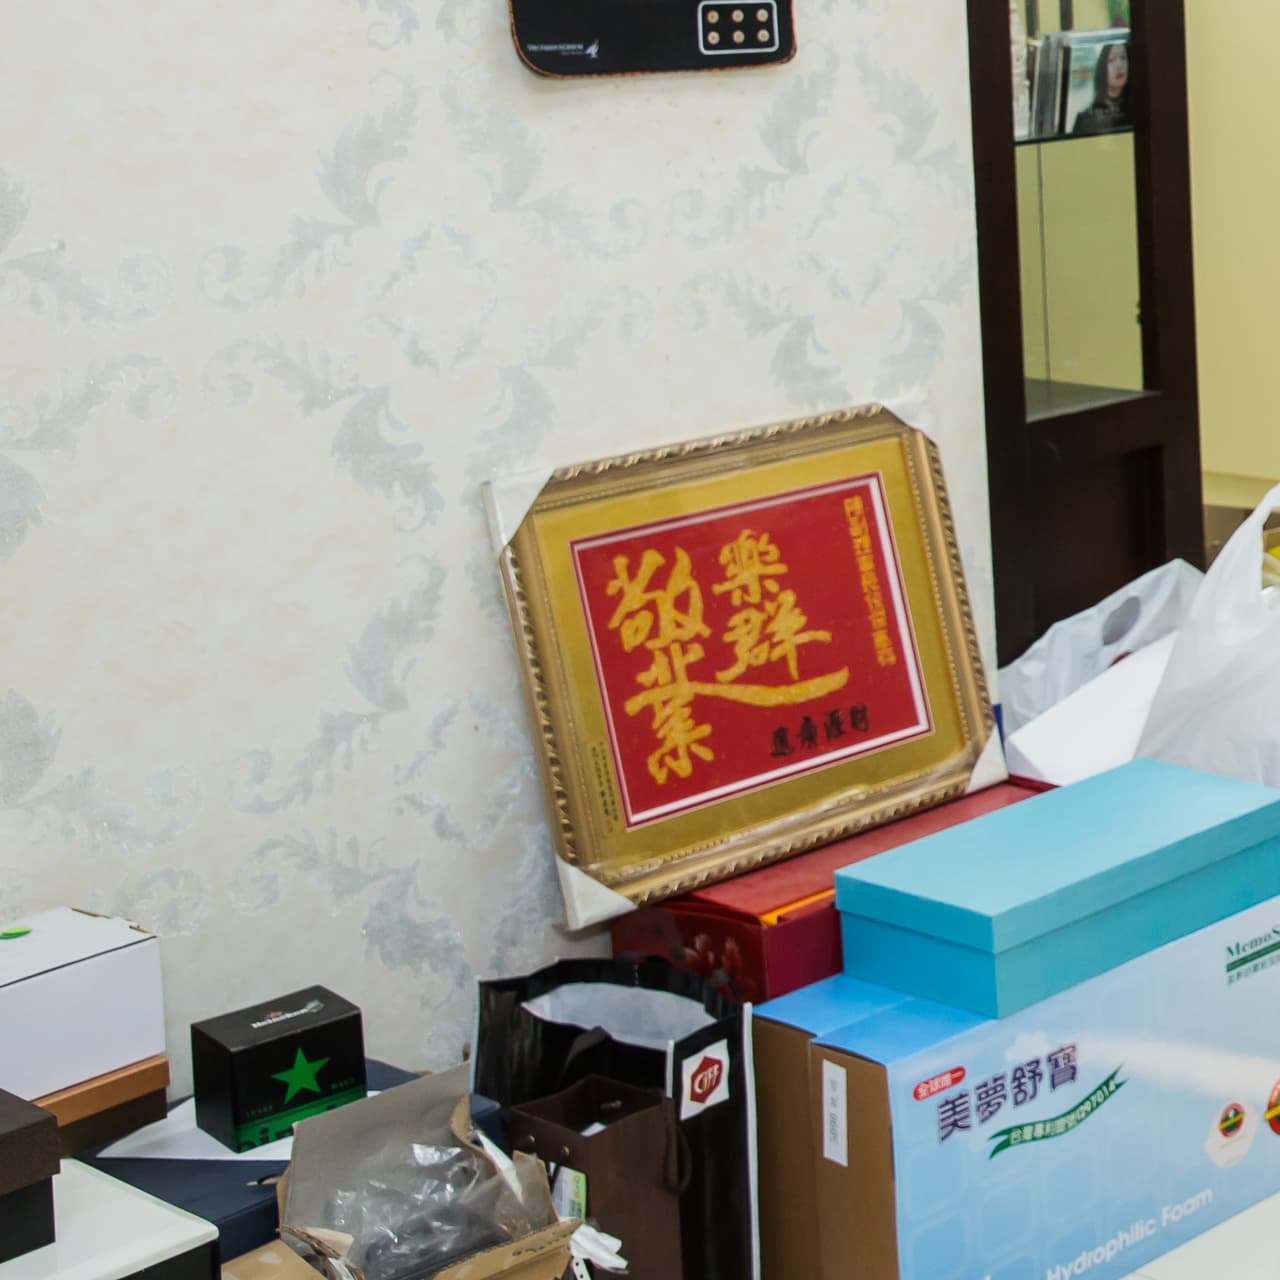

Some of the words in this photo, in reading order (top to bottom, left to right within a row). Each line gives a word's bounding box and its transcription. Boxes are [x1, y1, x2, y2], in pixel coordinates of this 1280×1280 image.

[937, 1043, 1078, 1144] 美夢舒寶
[1046, 1216, 1156, 1280] Hydrophilic
[1160, 1187, 1213, 1228] Foam
